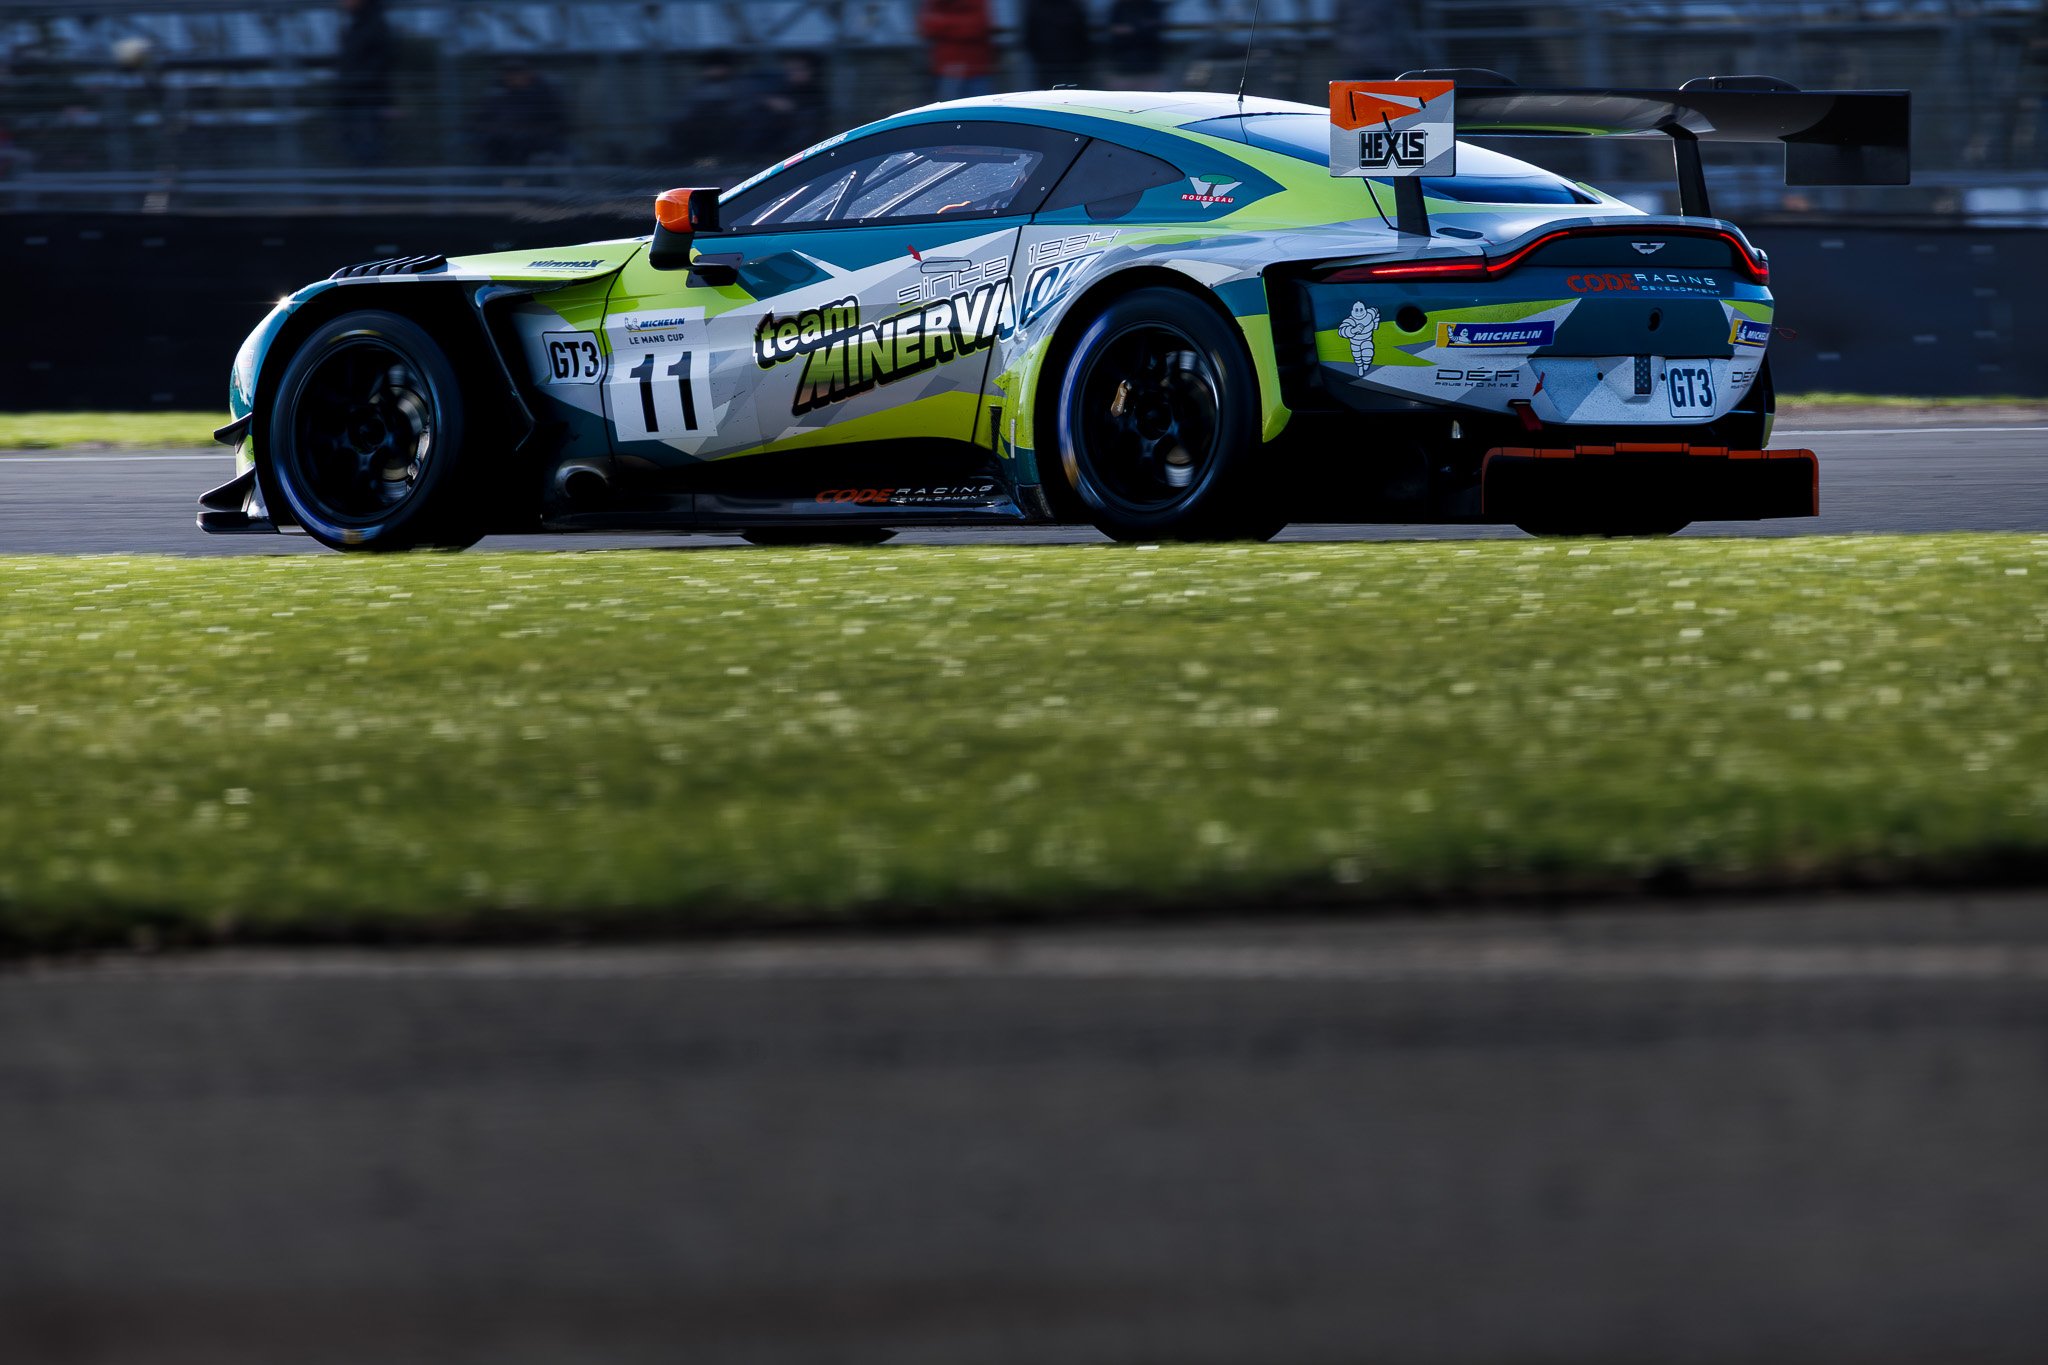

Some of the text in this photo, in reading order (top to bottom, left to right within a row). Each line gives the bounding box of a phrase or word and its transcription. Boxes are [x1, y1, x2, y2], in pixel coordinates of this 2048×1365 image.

[1360, 132, 1424, 167] HEXIS
[1181, 194, 1234, 203] ROUSSEAU
[897, 229, 1121, 304] since 1934
[1566, 273, 1716, 293] CODE RACING
[1641, 285, 1720, 295] DEVELOPMENT
[640, 317, 685, 328] MICHELIN
[754, 296, 861, 370] team
[1473, 329, 1542, 341] MICHELIN
[629, 333, 684, 345] LE MANS CUP
[792, 277, 1016, 416] MINERVA
[550, 341, 599, 380] GT3
[630, 351, 698, 433] 11
[1669, 368, 1713, 408] GT3
[816, 484, 995, 503] CODE RACING
